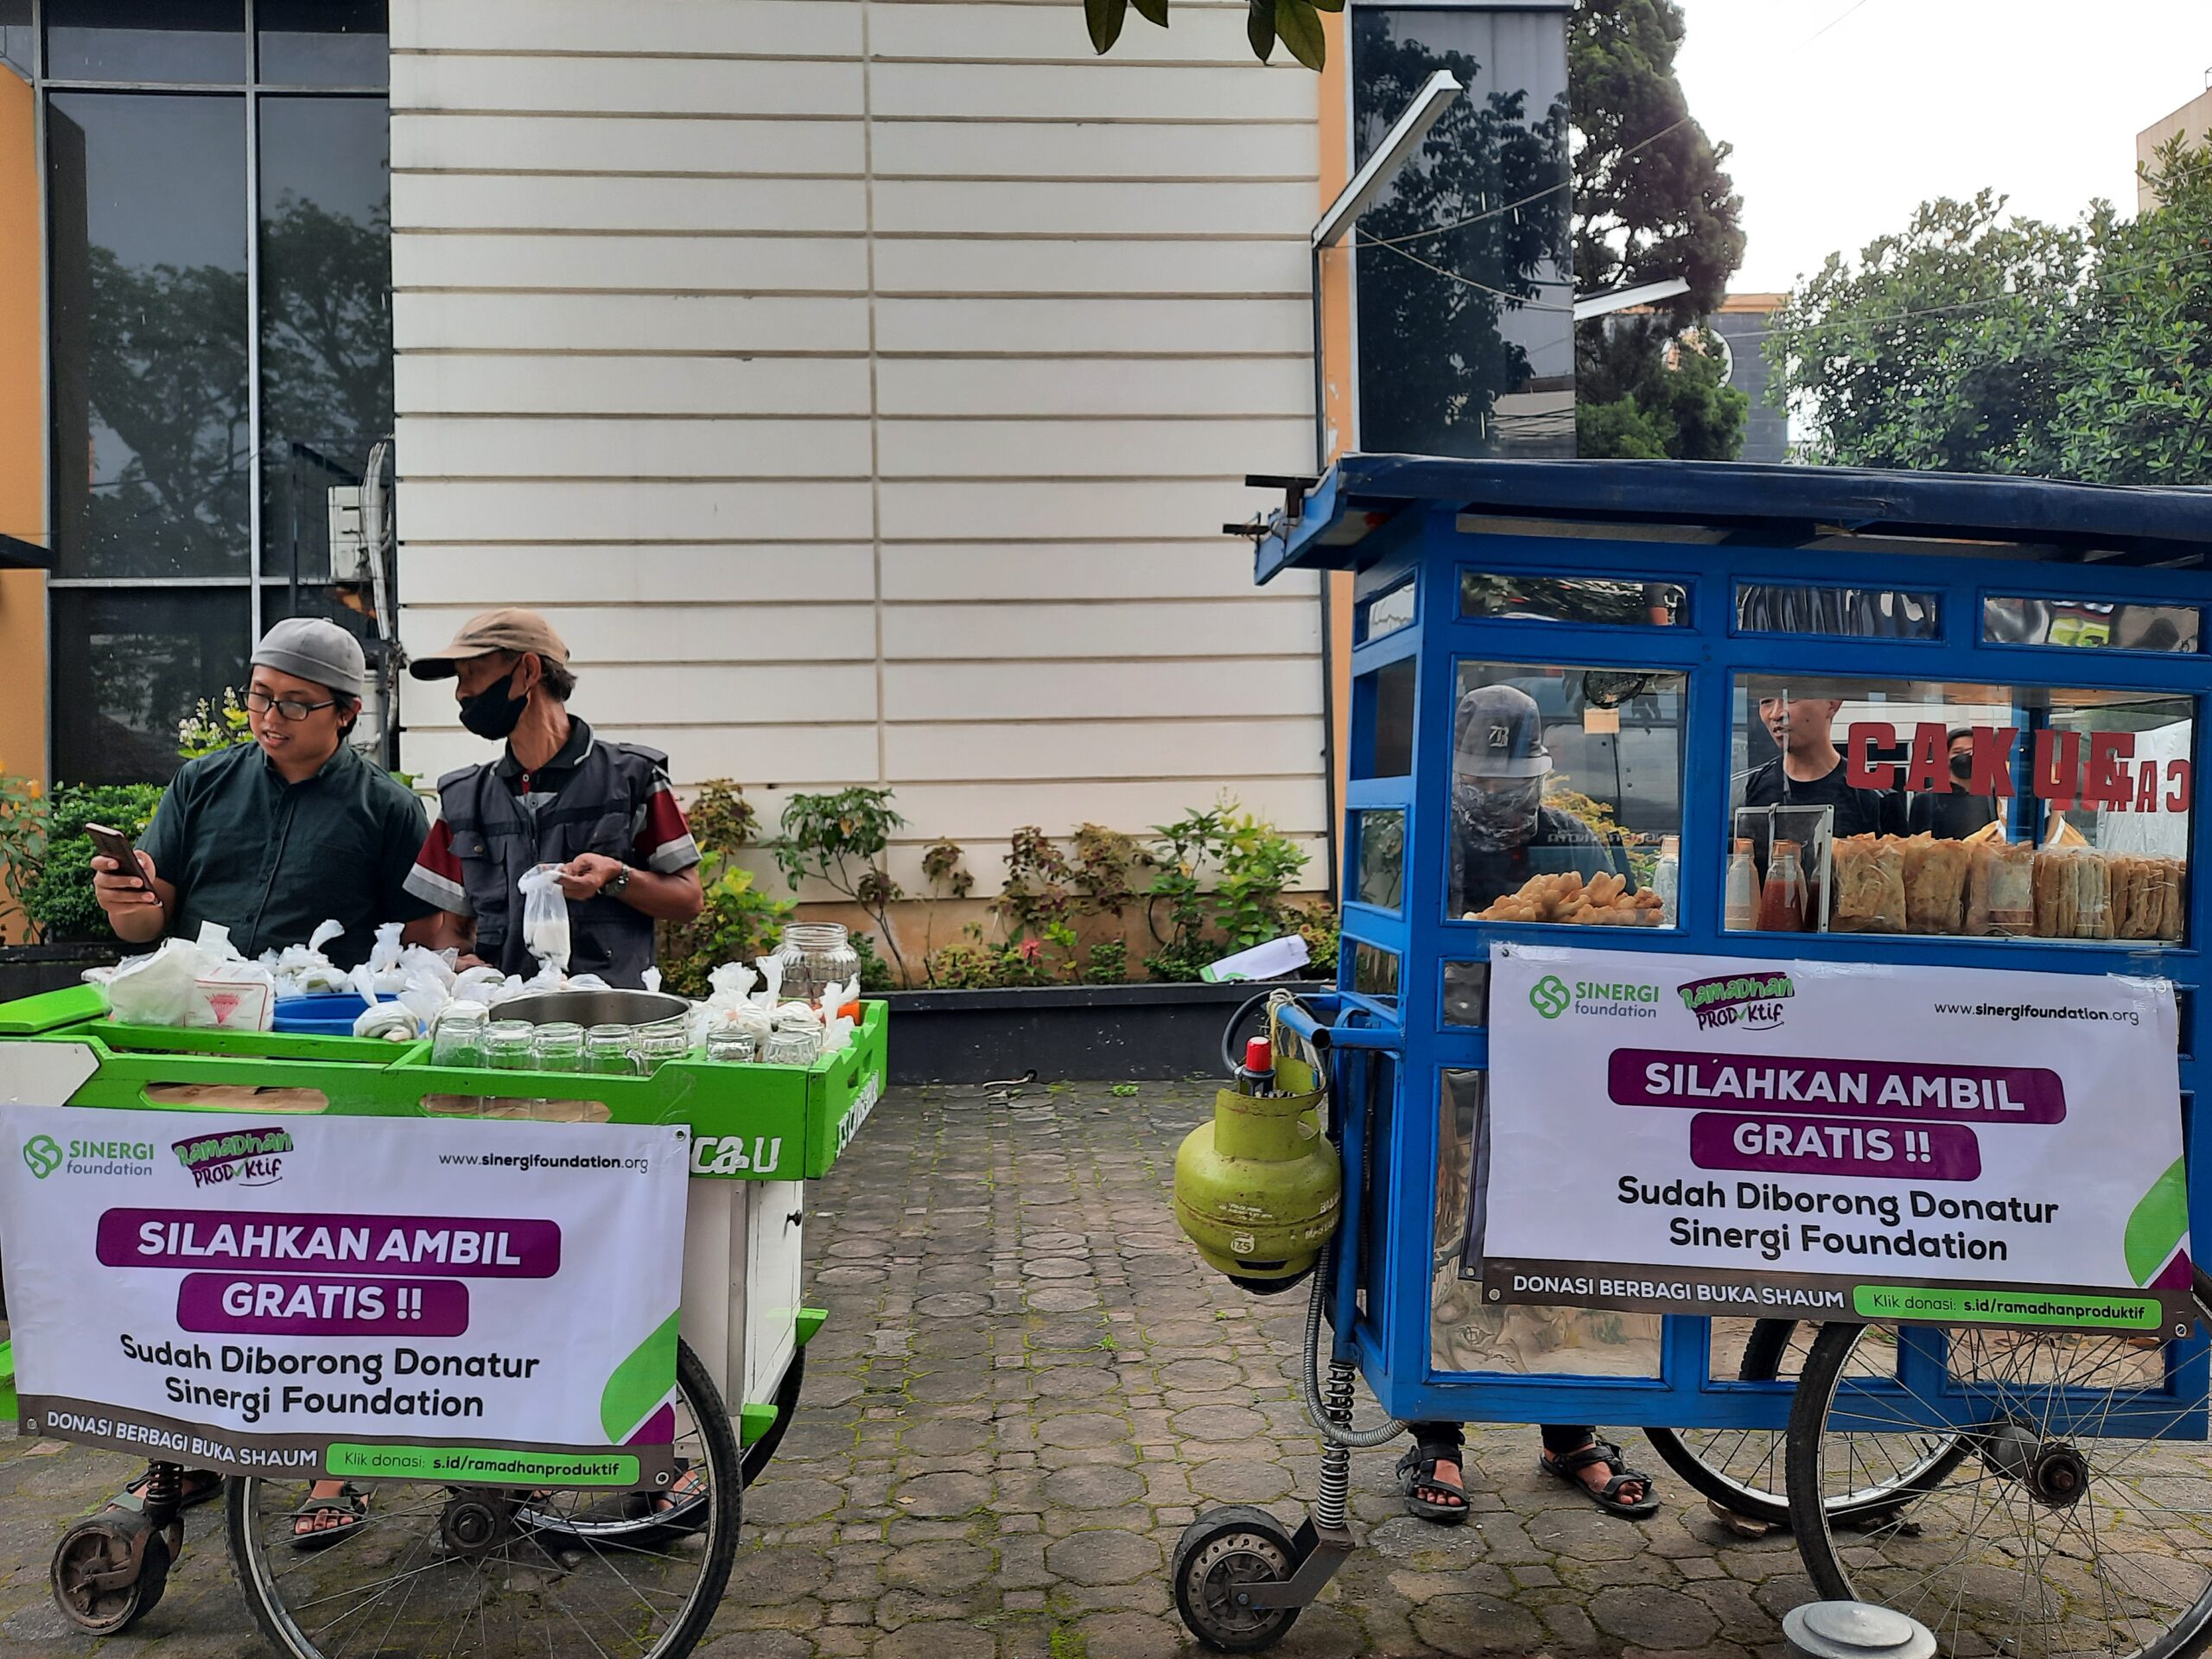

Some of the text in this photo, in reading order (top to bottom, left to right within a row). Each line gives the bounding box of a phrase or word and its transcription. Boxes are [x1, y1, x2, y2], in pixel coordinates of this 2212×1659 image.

[1847, 721, 2136, 803] CAKUE
[1574, 1001, 1657, 1019] foundation
[1575, 982, 1659, 1002] SINERGI
[1934, 1002, 2139, 1026] www.sinergifoundation.org
[1645, 1062, 2025, 1112] SILAHKAN AMBIL
[69, 1141, 154, 1160] SINERGI
[1732, 1122, 1932, 1163] GRATIS !!
[67, 1159, 152, 1176] foundation
[439, 1153, 648, 1173] www.sinergifoundation.org
[1618, 1176, 2059, 1227] Sudah Diborong Donatur
[137, 1221, 520, 1266] SILAHKAN AMBIL
[1669, 1217, 2007, 1261] Sinergi Foundation
[221, 1282, 423, 1320] GRATIS !!
[1513, 1275, 1845, 1308] DONASI BERBAGI BUKA SHAUM
[1873, 1294, 2145, 1321] Klik donasi: s.id/ramadhanproduktif
[120, 1334, 540, 1384] Sudah Diborong Donatur
[165, 1376, 484, 1423] Sinergi Foundation
[48, 1411, 318, 1467] DONASI BERBAGI BUKA SHAUM
[345, 1452, 620, 1478] Klik donasi: s.id/ramadhanproduktif
